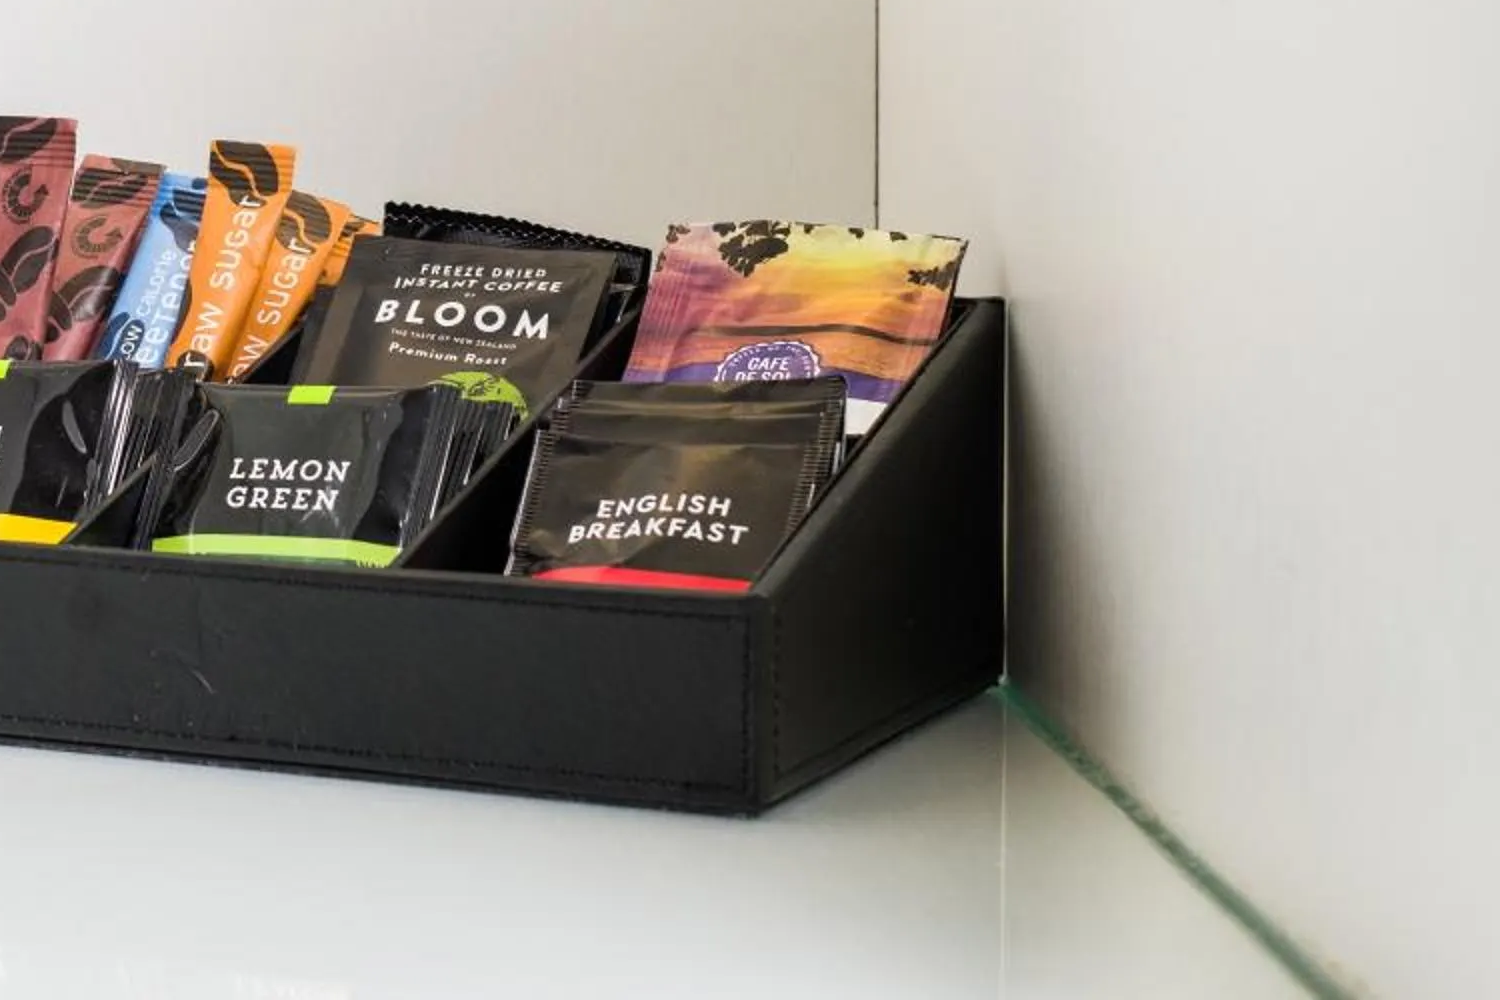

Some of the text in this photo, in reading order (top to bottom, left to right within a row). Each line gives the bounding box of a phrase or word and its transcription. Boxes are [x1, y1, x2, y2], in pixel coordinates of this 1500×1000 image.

[419, 264, 548, 279] FREEZE DRIED
[394, 276, 564, 293] INSTANT COFFEE
[374, 299, 550, 340] BLOOM
[453, 336, 473, 345] NEW
[227, 334, 269, 384] aw
[389, 341, 508, 366] Premium Roast
[229, 458, 351, 483] LEMON
[226, 486, 340, 511] GREEN
[596, 493, 732, 518] ENGLISH
[567, 517, 749, 545] BREAKFAST
